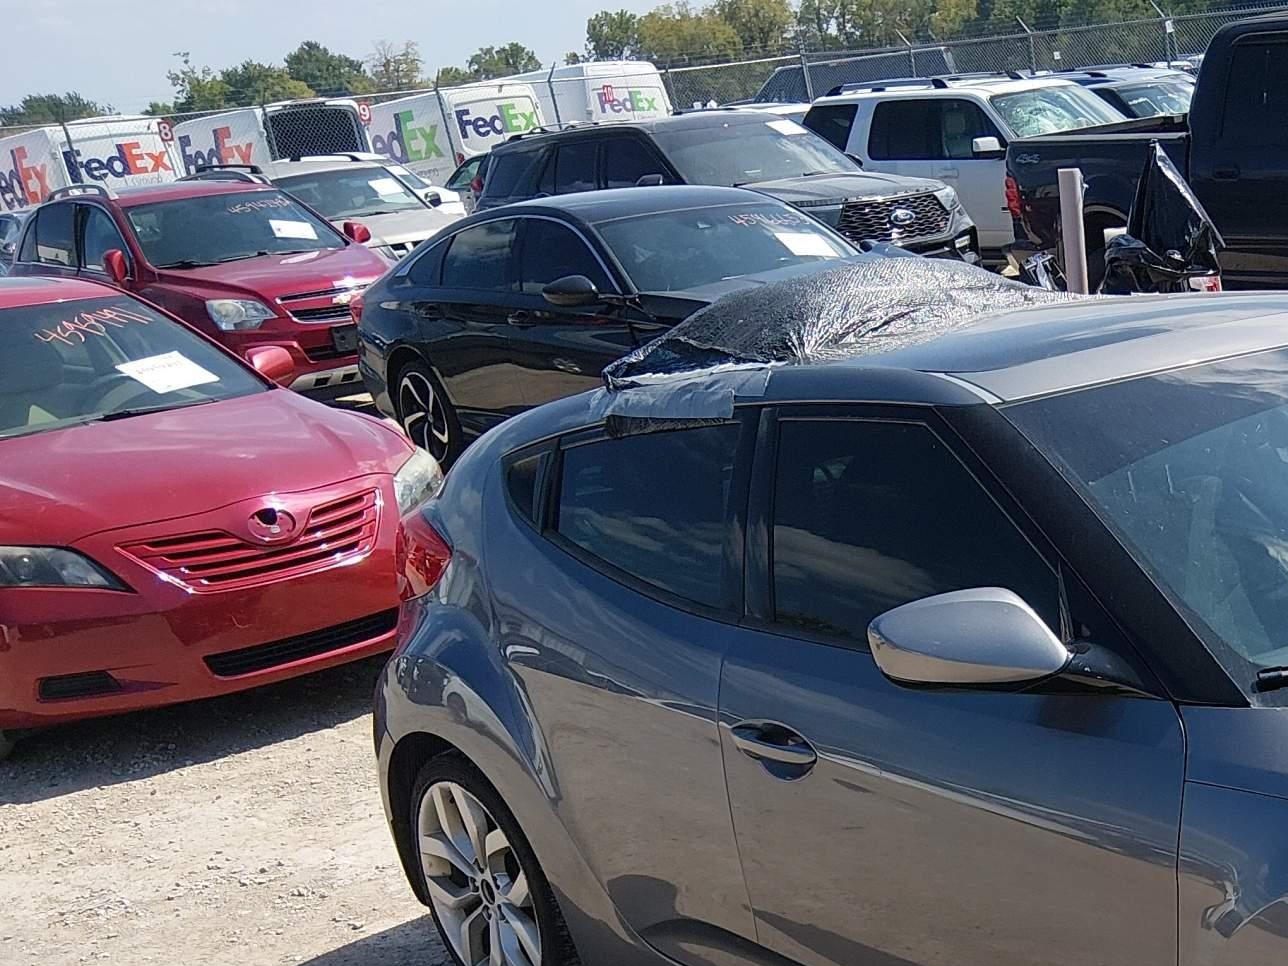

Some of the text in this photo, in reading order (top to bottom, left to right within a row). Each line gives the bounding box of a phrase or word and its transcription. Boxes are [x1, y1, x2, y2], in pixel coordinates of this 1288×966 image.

[359, 104, 370, 120] 9
[455, 103, 539, 139] FedEx
[161, 122, 171, 142] 8
[372, 110, 443, 164] edEx
[0, 145, 50, 210] edEx
[62, 142, 174, 184] FedEx
